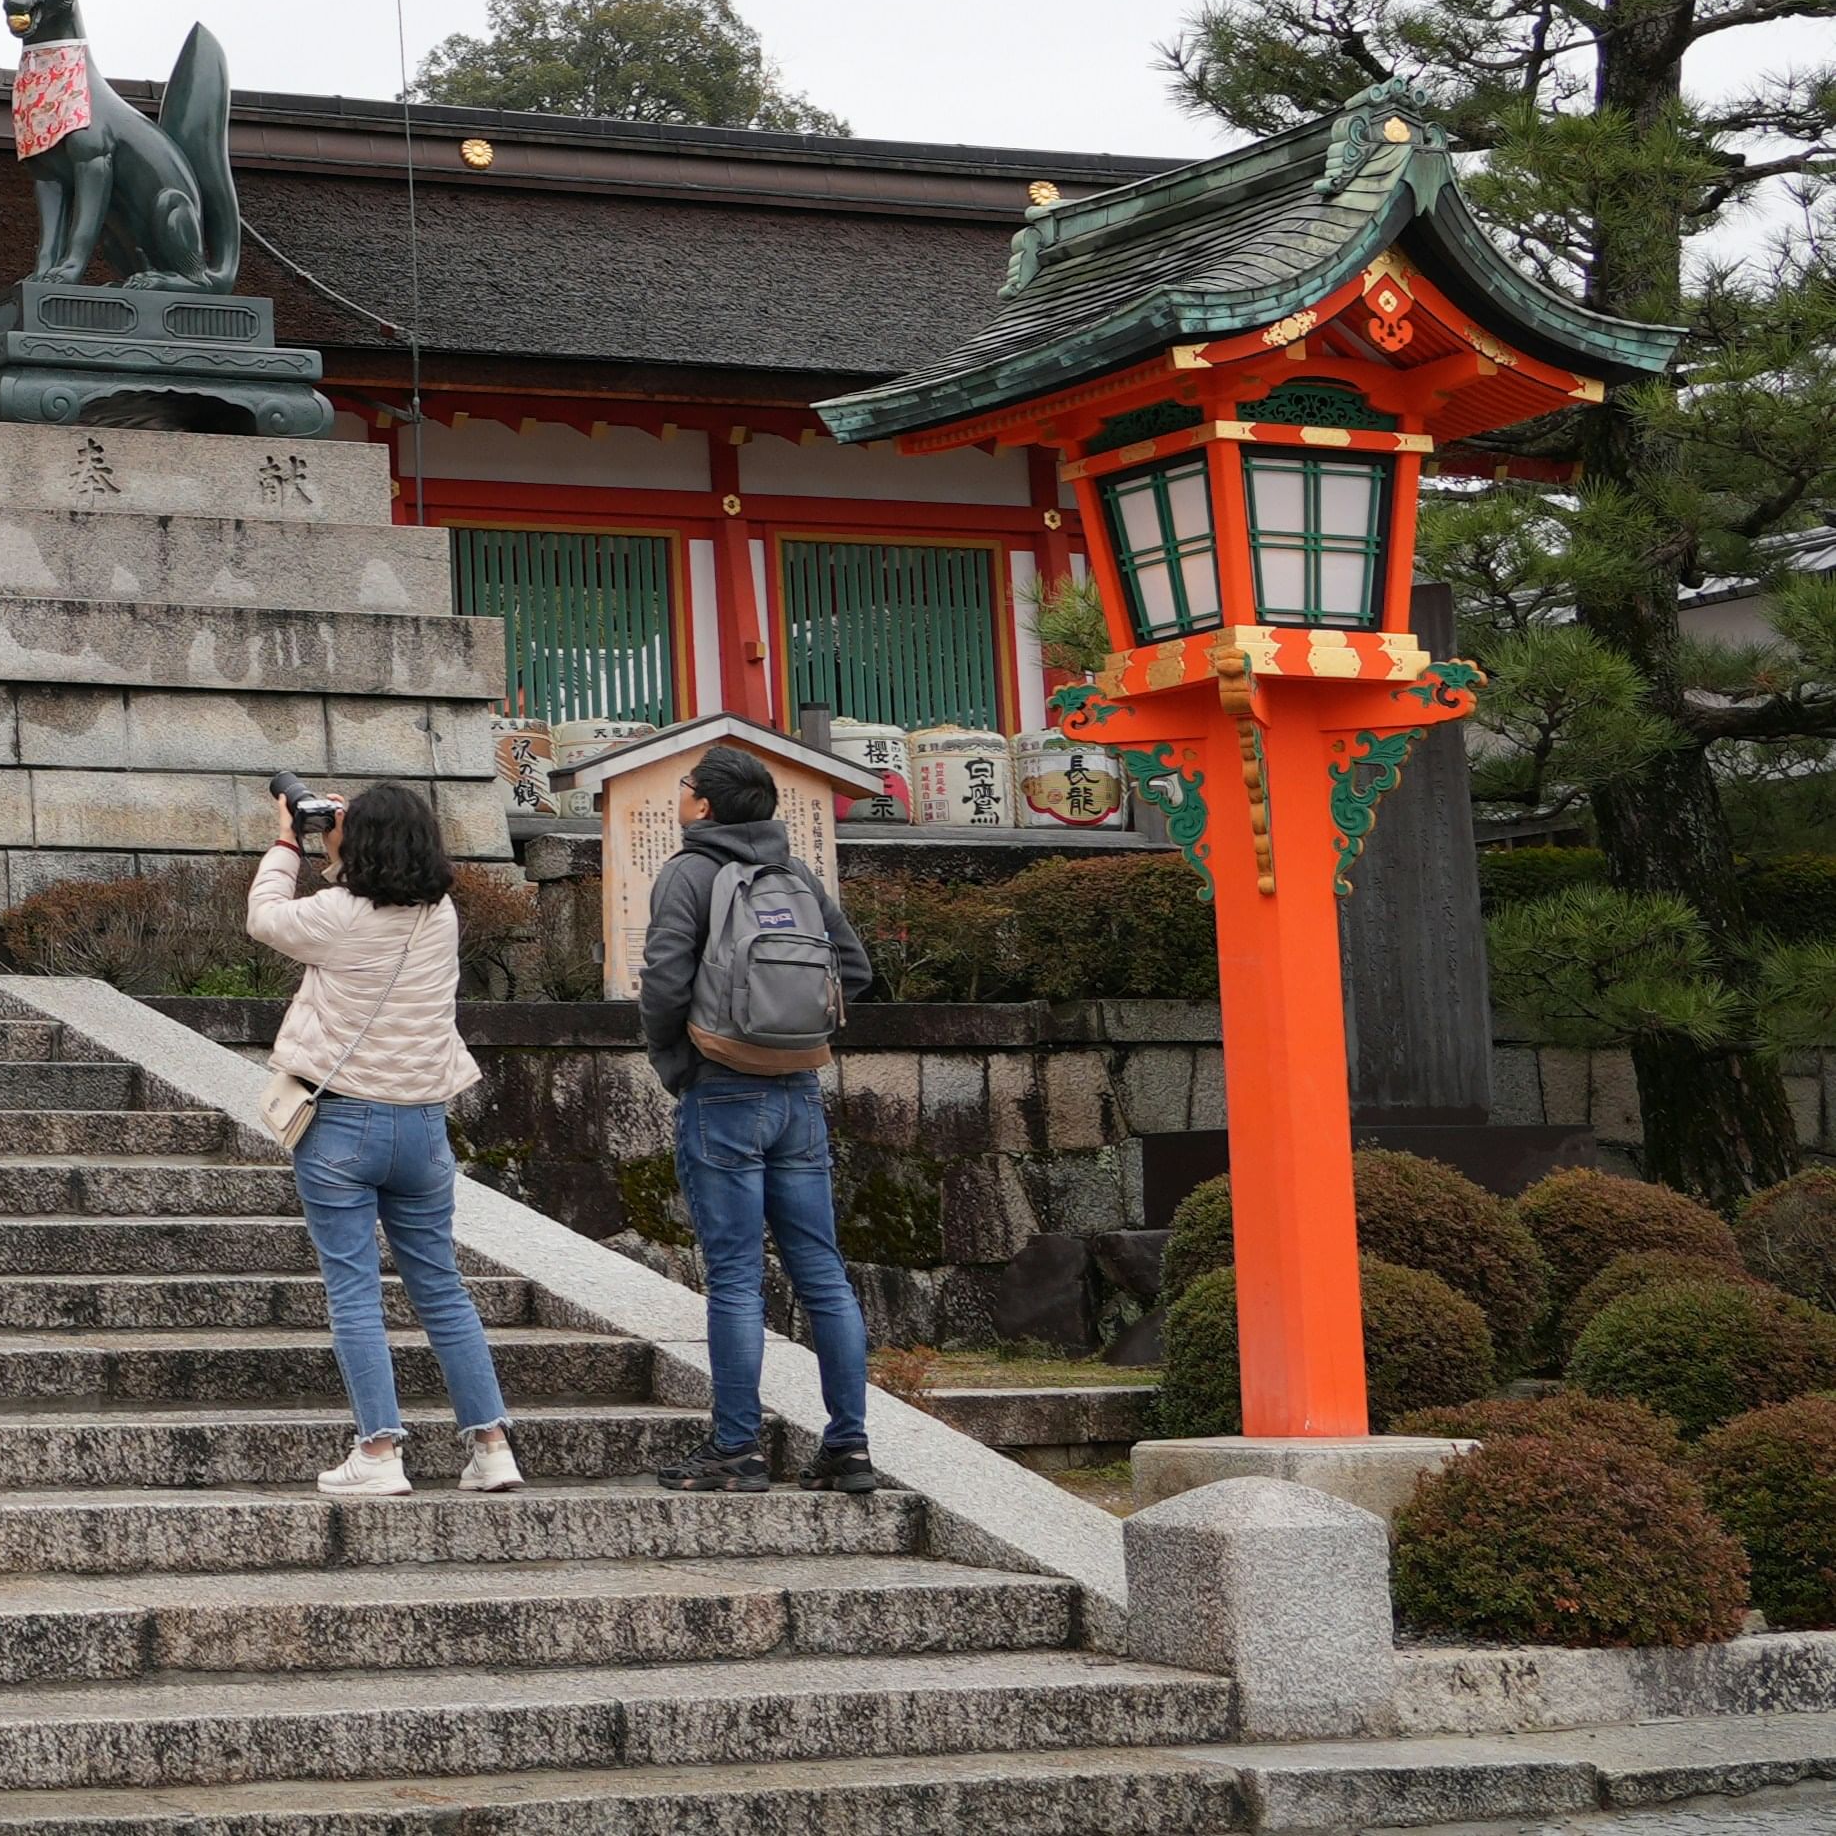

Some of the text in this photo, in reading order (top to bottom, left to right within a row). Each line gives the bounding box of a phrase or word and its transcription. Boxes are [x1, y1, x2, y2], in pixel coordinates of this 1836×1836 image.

[511, 738, 540, 807] 沢の鶴
[863, 740, 895, 818] 櫻宗
[1064, 755, 1102, 815] 長龍
[811, 799, 825, 877] 伏見稲荷大社
